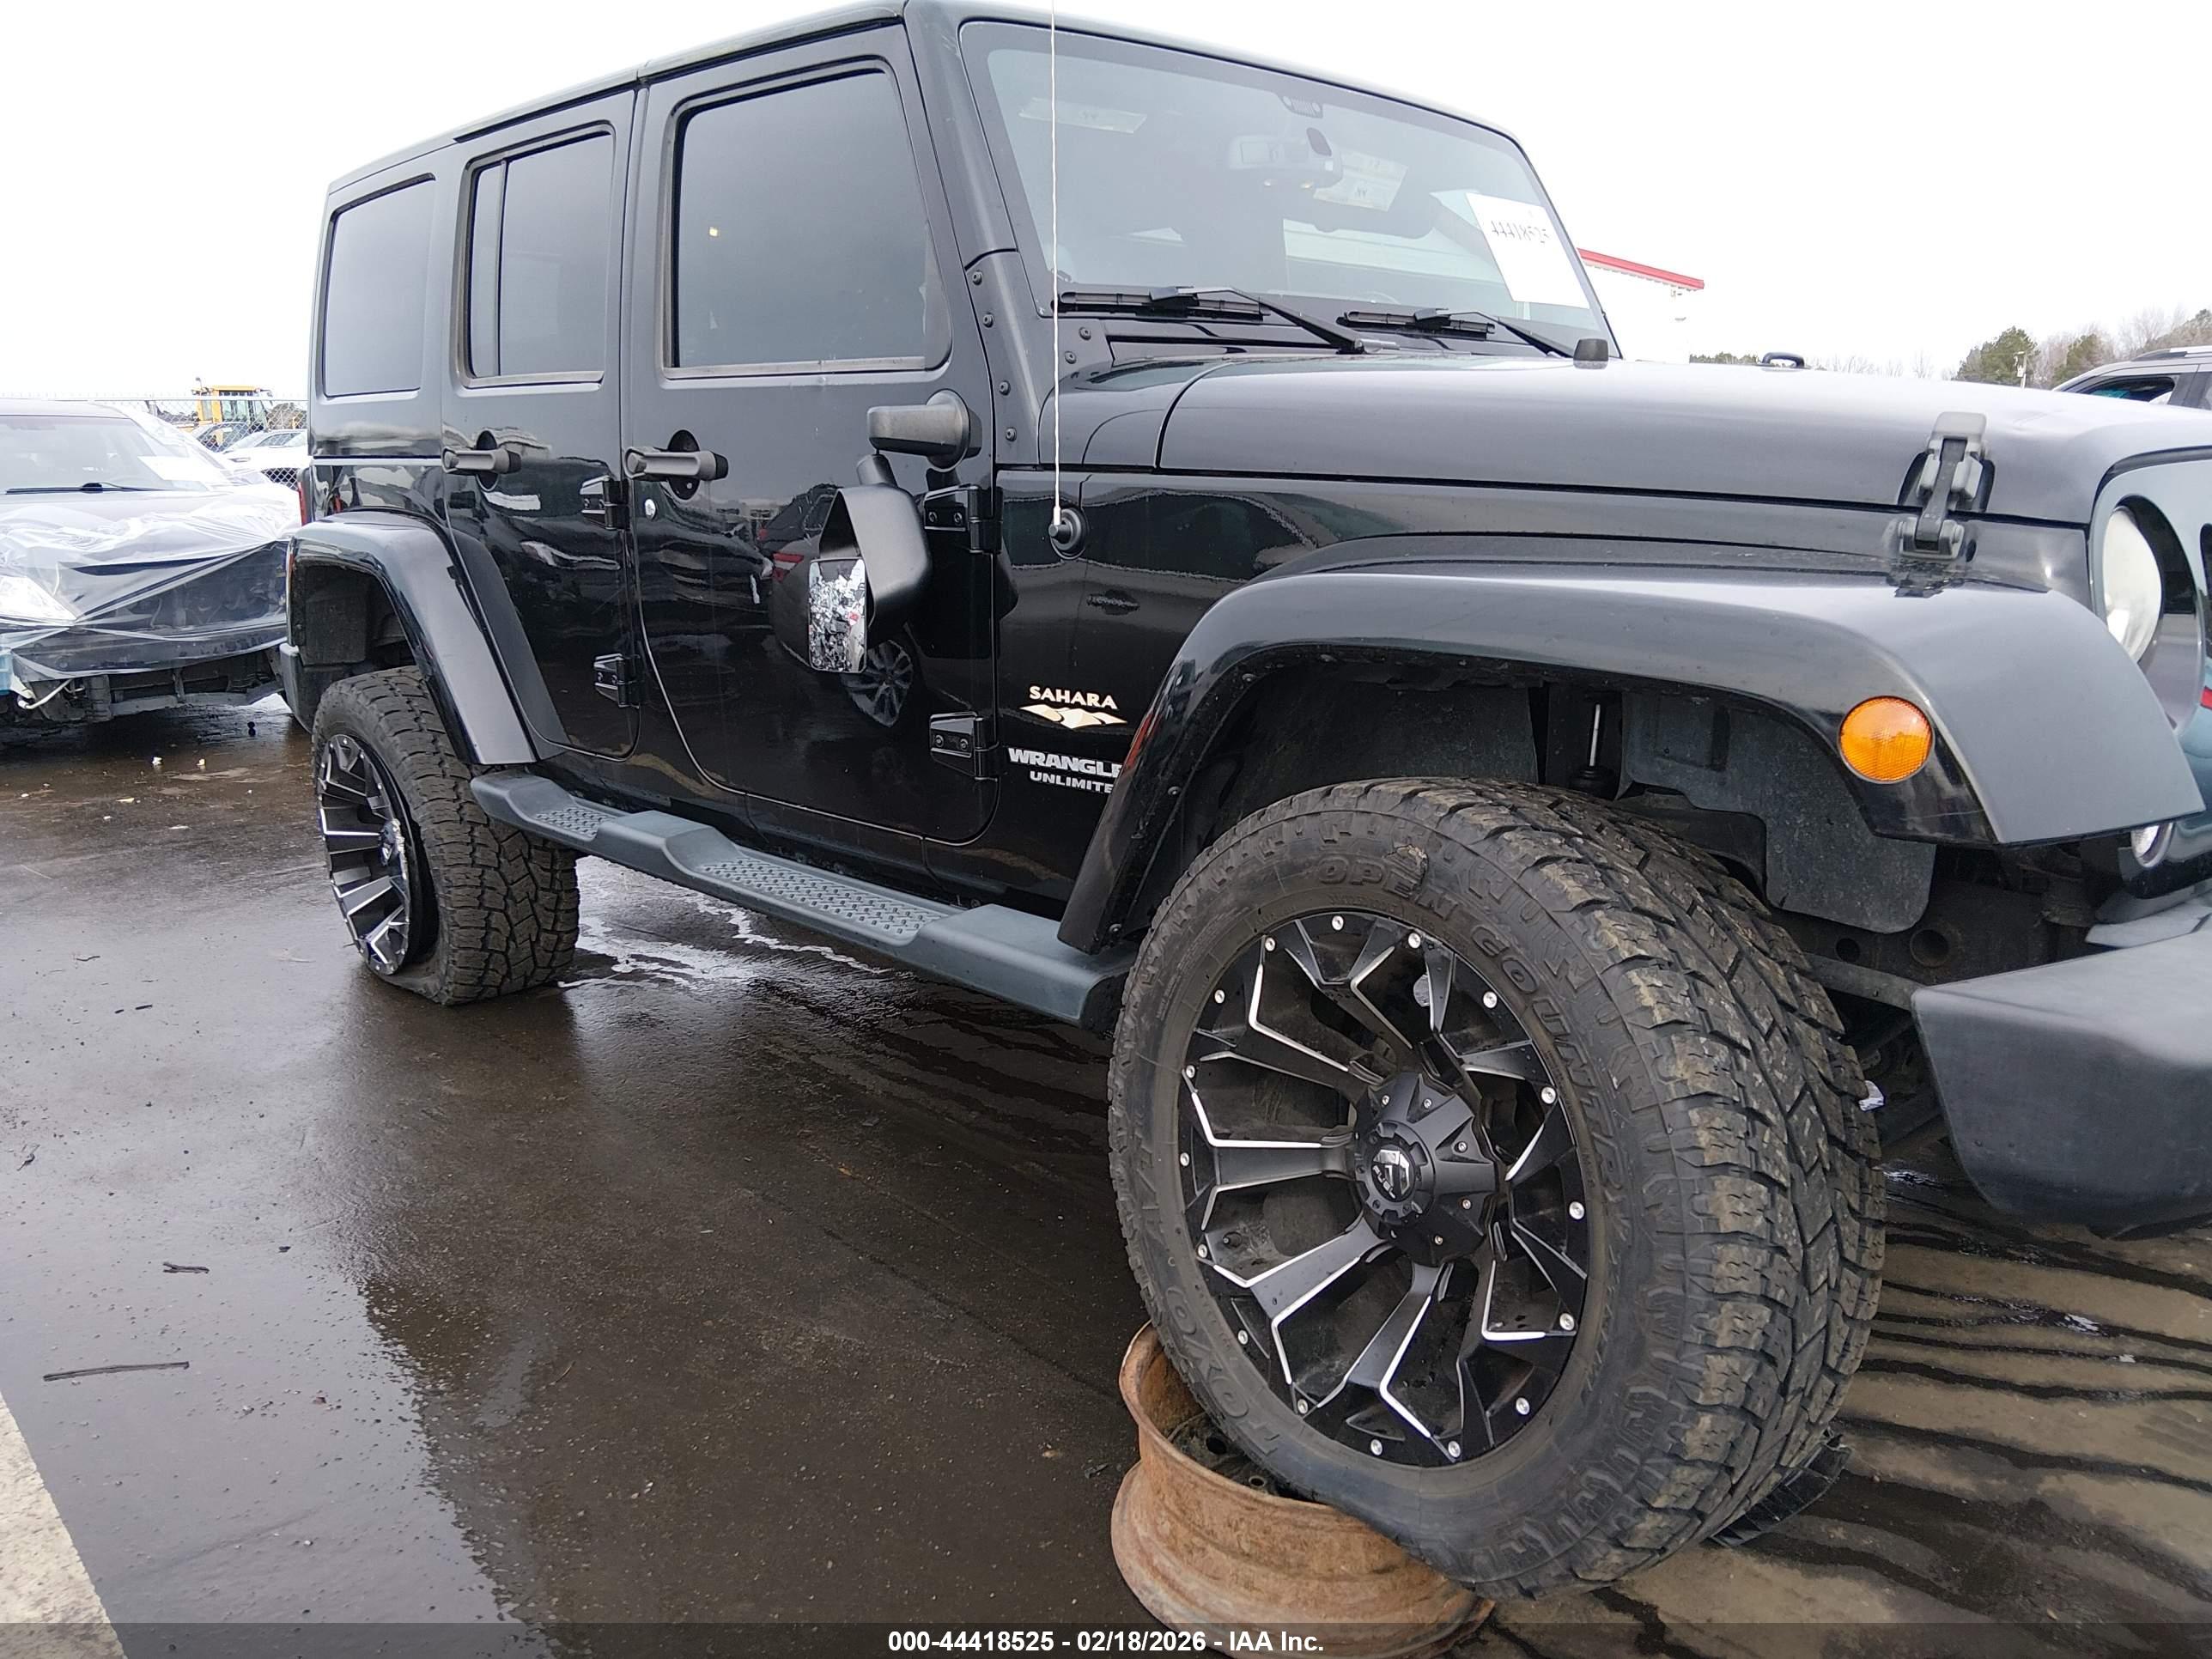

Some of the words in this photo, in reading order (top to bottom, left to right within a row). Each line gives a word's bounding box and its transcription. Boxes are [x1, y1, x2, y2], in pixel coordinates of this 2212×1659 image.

[1029, 685, 1118, 709] SAHARA
[1317, 855, 1458, 921] OPEN
[1371, 1165, 1396, 1200] FUEL
[1164, 1285, 1281, 1456] TOYO
